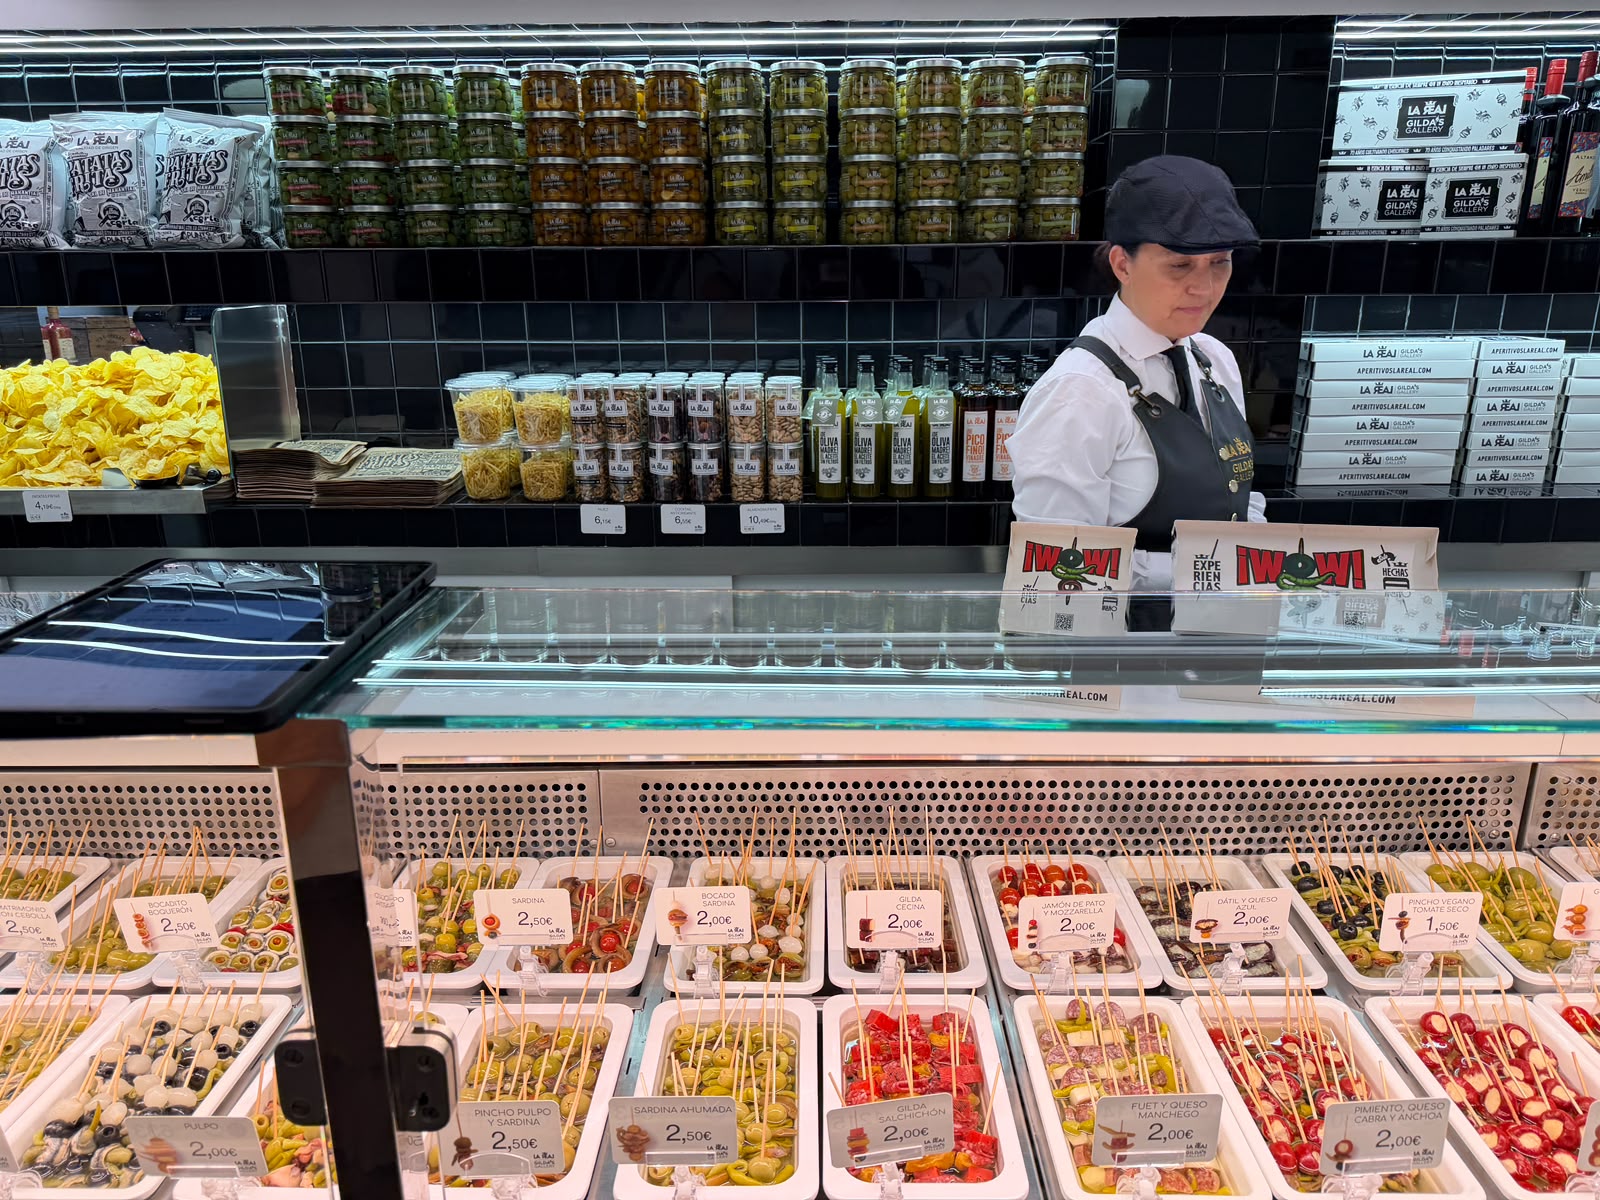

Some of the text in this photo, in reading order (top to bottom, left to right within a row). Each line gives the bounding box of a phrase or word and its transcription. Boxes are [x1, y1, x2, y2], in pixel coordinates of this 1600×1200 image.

[1408, 106, 1421, 115] LA
[1406, 116, 1444, 127] GILDA'S
[1405, 126, 1444, 134] GALLERY
[77, 138, 89, 146] LA
[166, 150, 228, 174] PATATAS
[1388, 189, 1397, 198] LA
[1455, 188, 1466, 196] LA
[1386, 200, 1417, 209] GILDA'S
[1454, 198, 1489, 207] GILDA'S
[1453, 205, 1488, 213] GALLERY
[1363, 350, 1373, 358] LA
[1492, 366, 1502, 374] LA
[1360, 386, 1370, 394] LA
[820, 437, 838, 447] OLIVA
[854, 438, 872, 447] OLIVA
[893, 437, 911, 447] OLIVA
[932, 437, 950, 446] OLIVA
[966, 434, 985, 445] PICO
[1349, 456, 1359, 465] LA
[1194, 560, 1221, 571] EXPE
[1194, 572, 1221, 582] RIEN
[1382, 568, 1408, 577] HECHAS
[1193, 582, 1221, 592] CIAS
[148, 899, 188, 908] BOCADITO
[1042, 901, 1071, 910] JAMÓN
[1217, 897, 1238, 905] DÁTIL
[1248, 896, 1278, 904] QUESO
[148, 906, 193, 916] BOQUERÓN
[1050, 907, 1104, 915] MOZZARELLA
[518, 911, 553, 928] 2,50€
[697, 911, 732, 927] 2,00€
[887, 914, 923, 930] 2,00€
[1233, 911, 1269, 926] 2,00€
[6, 920, 42, 935] 2,50€
[160, 917, 197, 934] 2,50€
[1060, 918, 1095, 933] 2,00€
[1426, 916, 1459, 932] 1,50€
[634, 1106, 733, 1114] SARDINA AHUMADA
[897, 1104, 927, 1113] GILDA
[1170, 1101, 1208, 1109] QUESO
[1354, 1102, 1445, 1114] PIMIENTO, QUESO
[474, 1108, 552, 1117] PINCHO PULPO
[879, 1108, 946, 1123] SALCHICHÓN
[1138, 1110, 1199, 1119] MANCHEGO
[1354, 1114, 1386, 1123] CABRA
[1398, 1112, 1443, 1121] ANCHOA
[184, 1122, 219, 1130] PULPO
[488, 1117, 540, 1127] Y SARDINA
[666, 1124, 712, 1143] 2,50€
[884, 1126, 929, 1142] 2,00€
[1147, 1124, 1193, 1142] 2,00€
[491, 1131, 538, 1152] 2,50€
[1376, 1130, 1421, 1149] 2,00€
[189, 1142, 237, 1158] 2,00€
